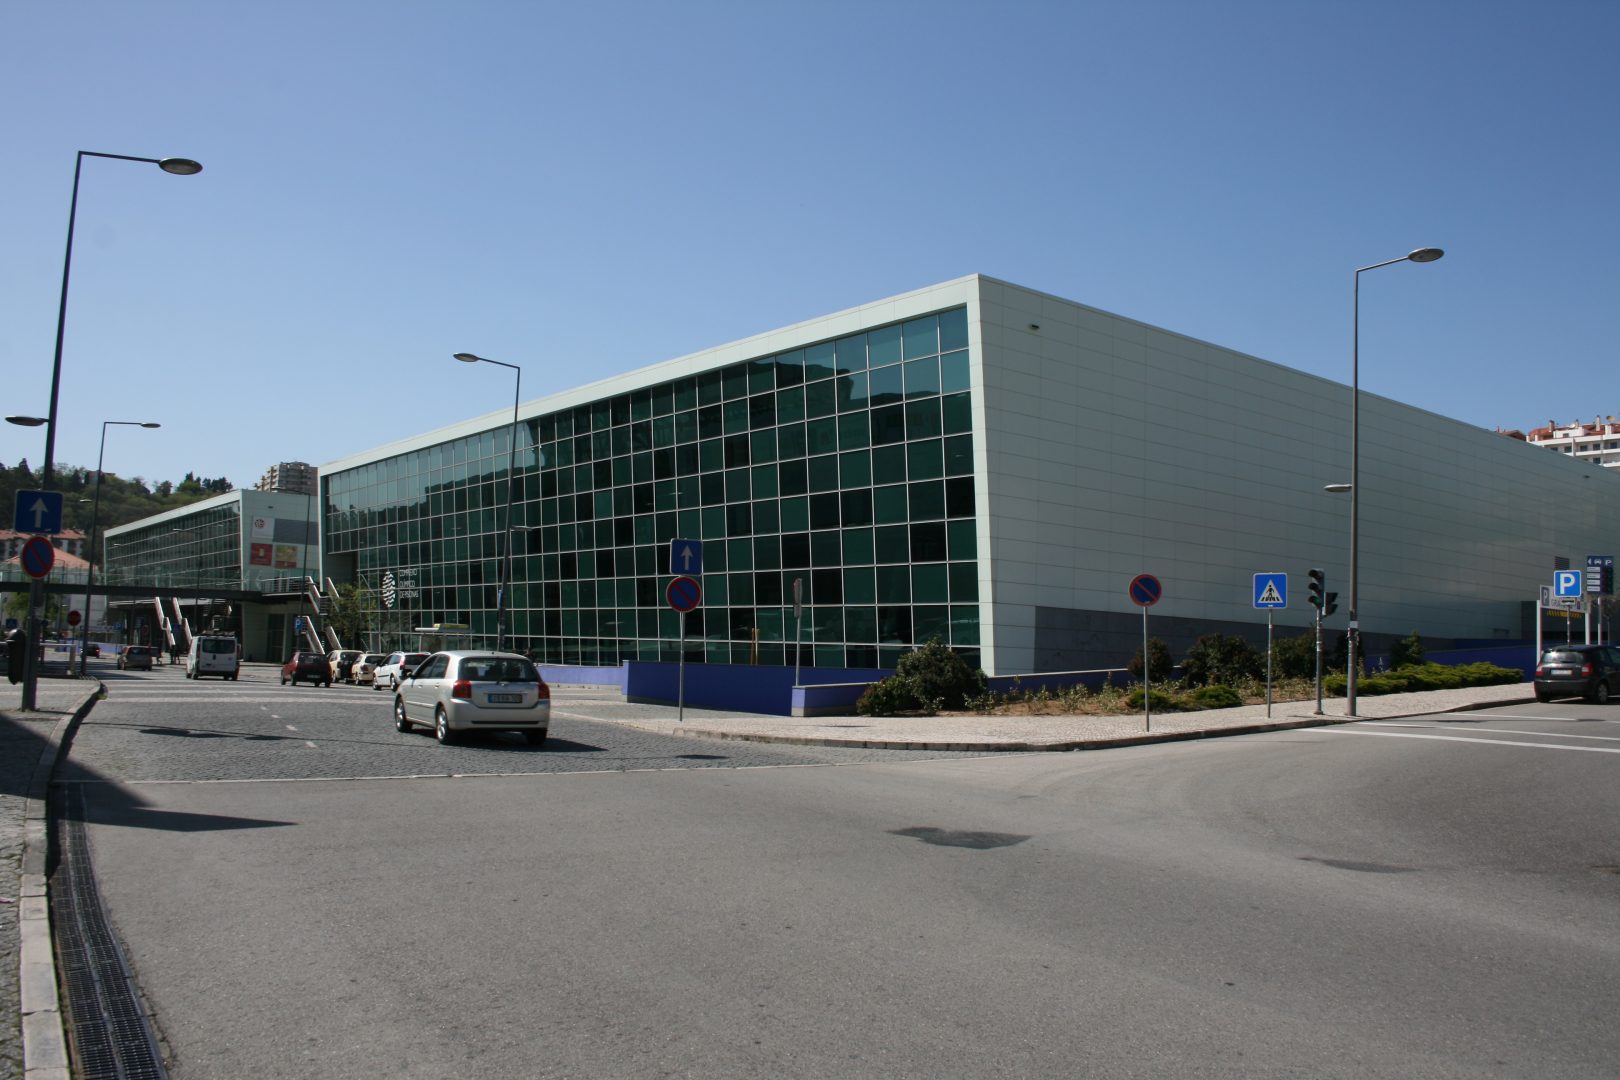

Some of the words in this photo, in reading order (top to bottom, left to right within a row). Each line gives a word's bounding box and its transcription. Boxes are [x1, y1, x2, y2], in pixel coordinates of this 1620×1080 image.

[1559, 573, 1575, 594] P
[1543, 590, 1548, 603] P
[295, 619, 301, 628] P
